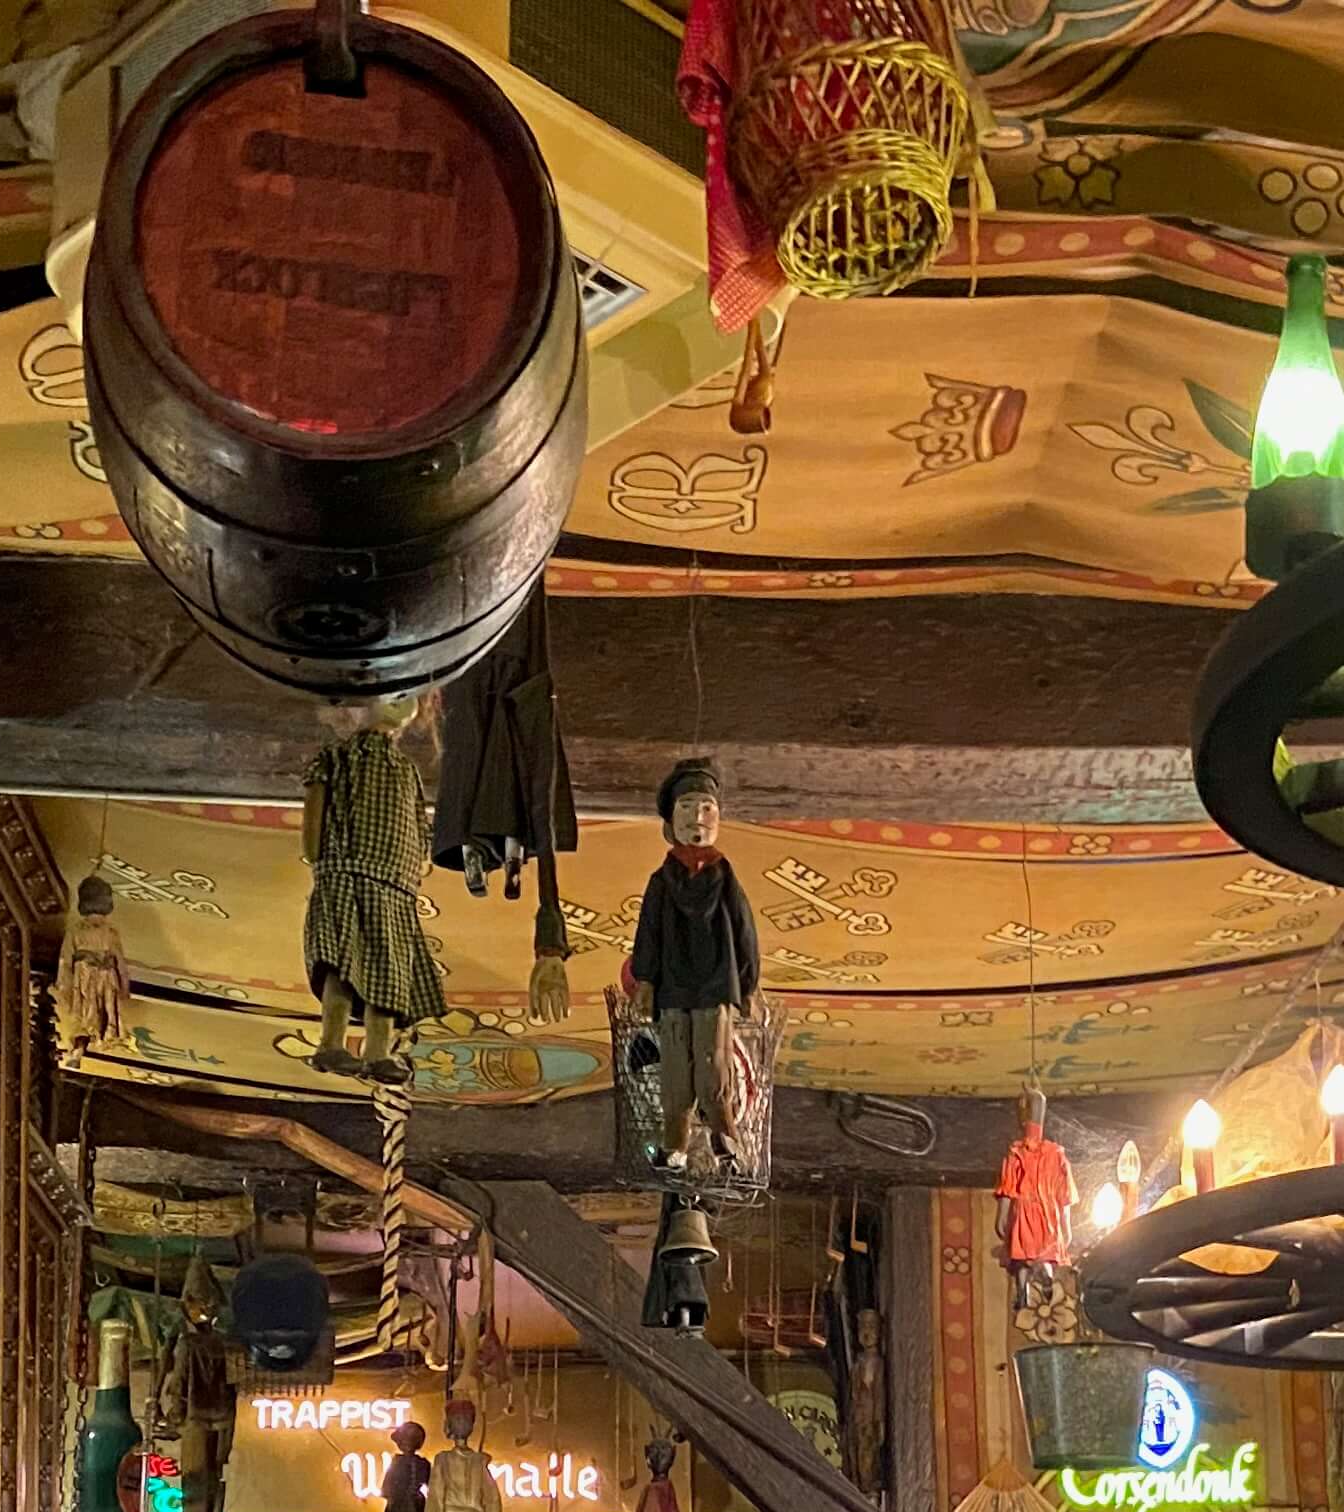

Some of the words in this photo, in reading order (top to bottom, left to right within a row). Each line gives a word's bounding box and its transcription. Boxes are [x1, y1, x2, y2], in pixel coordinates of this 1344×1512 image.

[252, 1398, 413, 1430] TRAPPIST
[340, 1451, 601, 1502] Wmalle
[1060, 1442, 1258, 1509] Corsendonk
